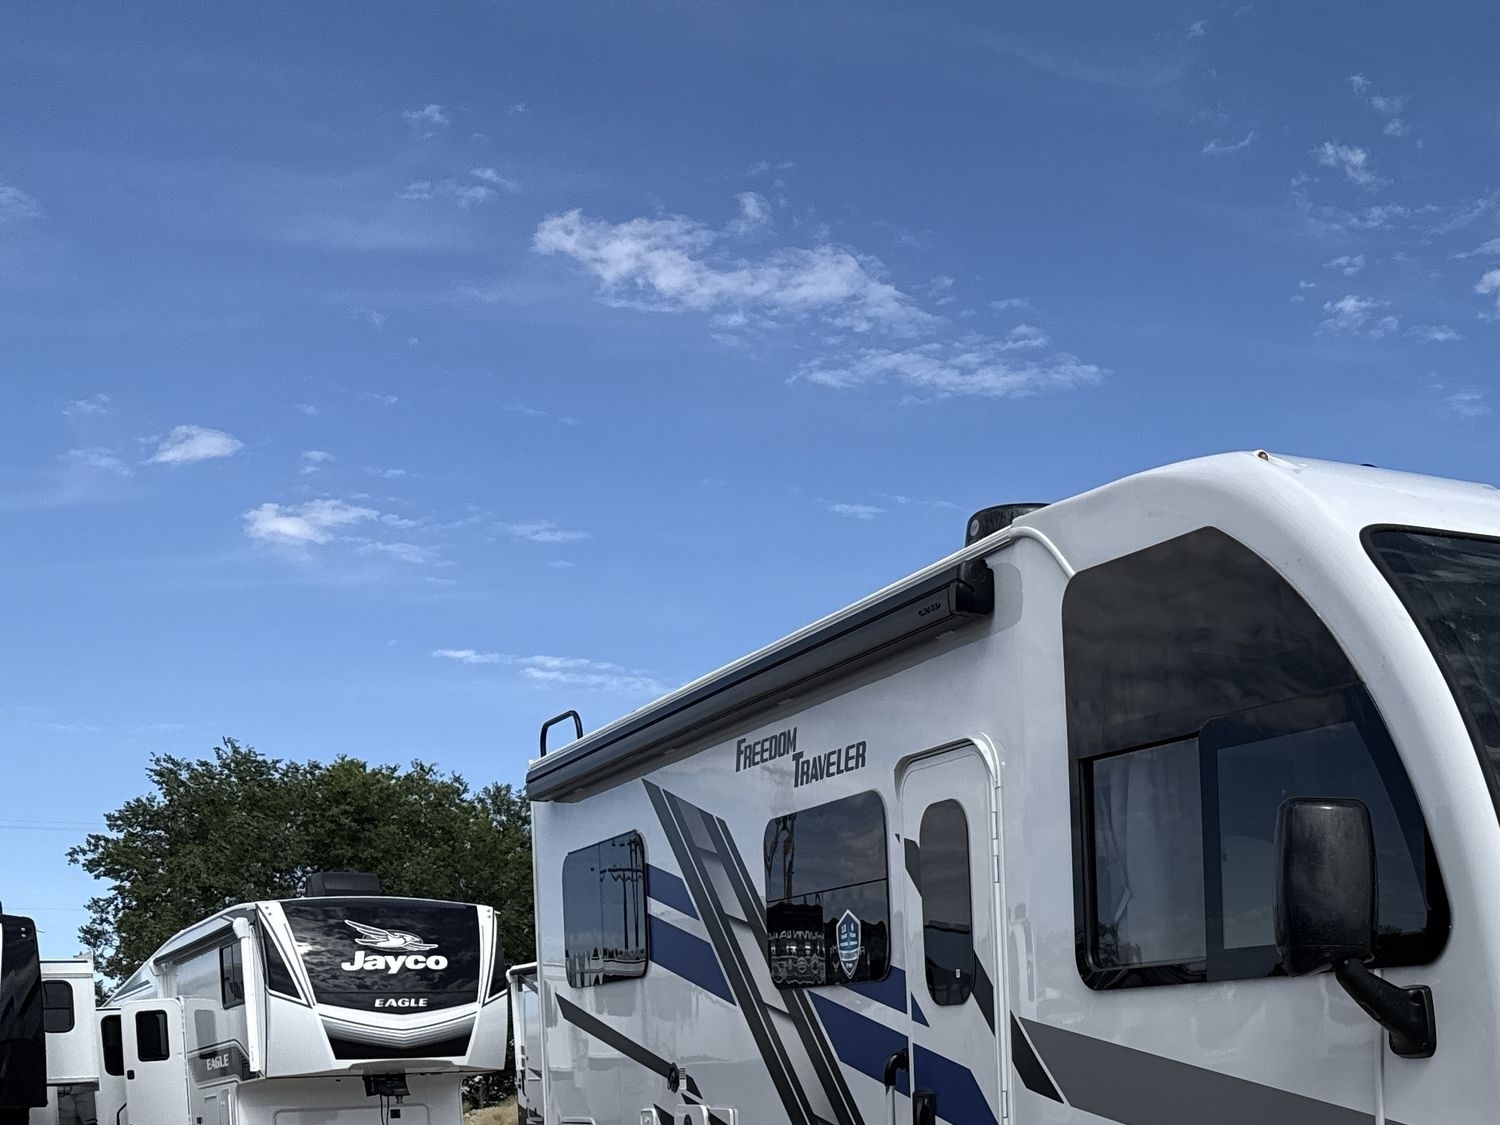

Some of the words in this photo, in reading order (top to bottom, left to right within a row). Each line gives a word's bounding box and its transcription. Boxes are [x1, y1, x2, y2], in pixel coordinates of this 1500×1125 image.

[735, 727, 797, 772] FREEDOM
[792, 740, 866, 788] TRAVELER
[341, 950, 448, 974] Jayco
[374, 998, 428, 1008] EAGLE
[206, 1054, 229, 1071] EAGLE
